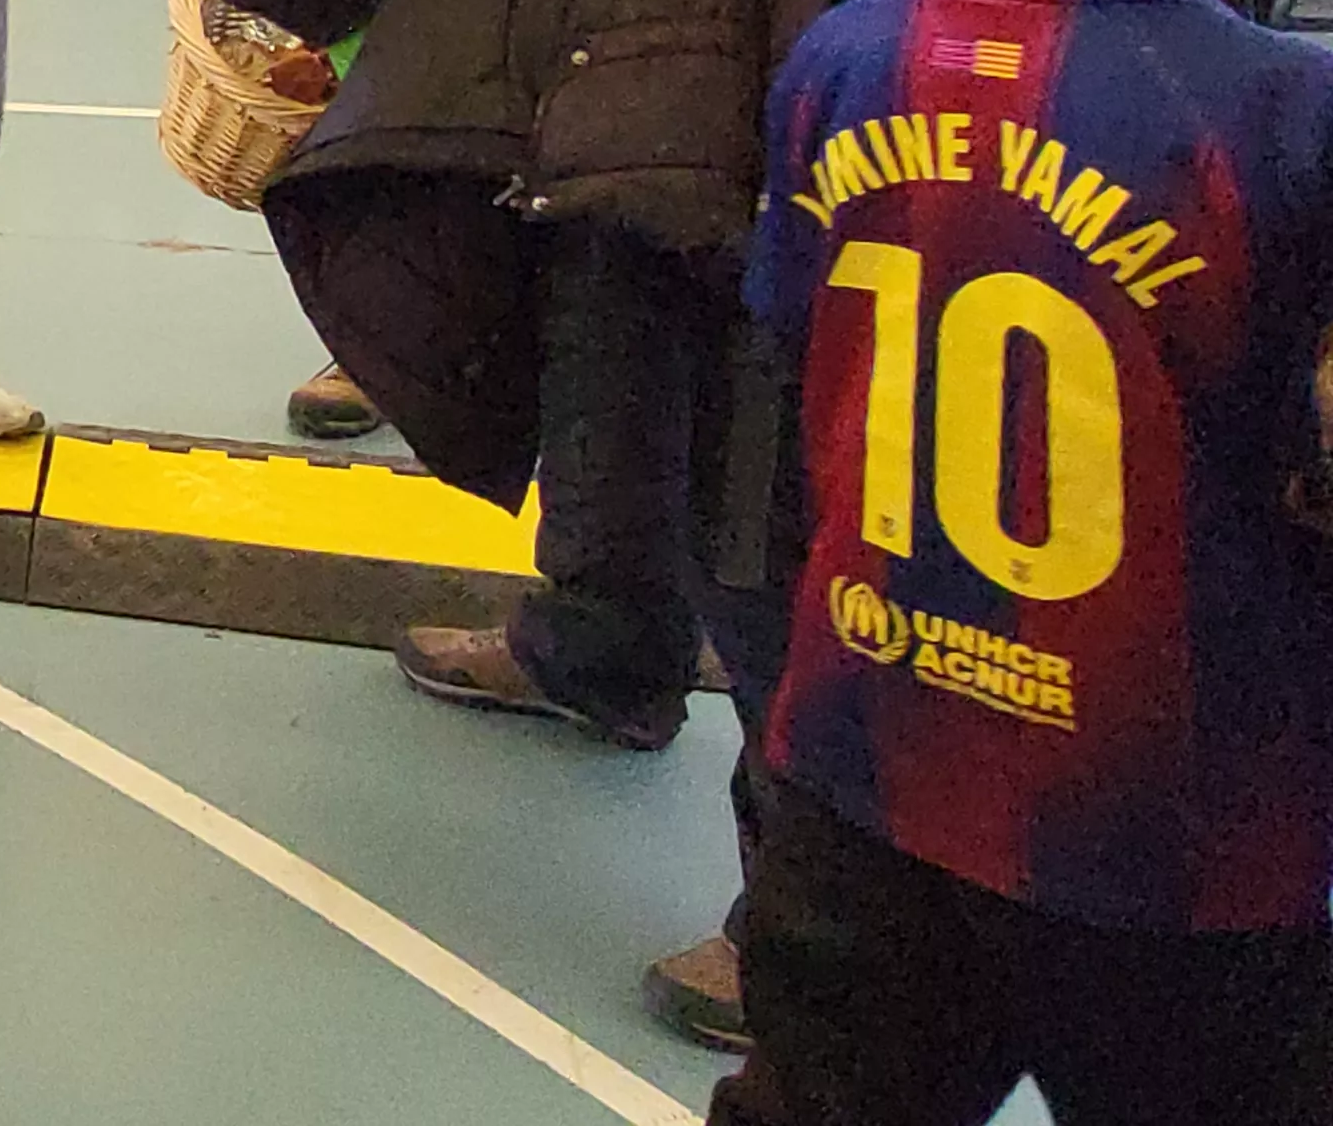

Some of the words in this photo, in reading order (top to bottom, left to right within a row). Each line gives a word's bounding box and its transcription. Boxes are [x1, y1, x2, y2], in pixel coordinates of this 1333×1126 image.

[999, 118, 1209, 309] YAMAL
[827, 240, 1125, 601] 10
[912, 610, 1074, 686] UNHCR
[912, 642, 1075, 717] ACNUR
